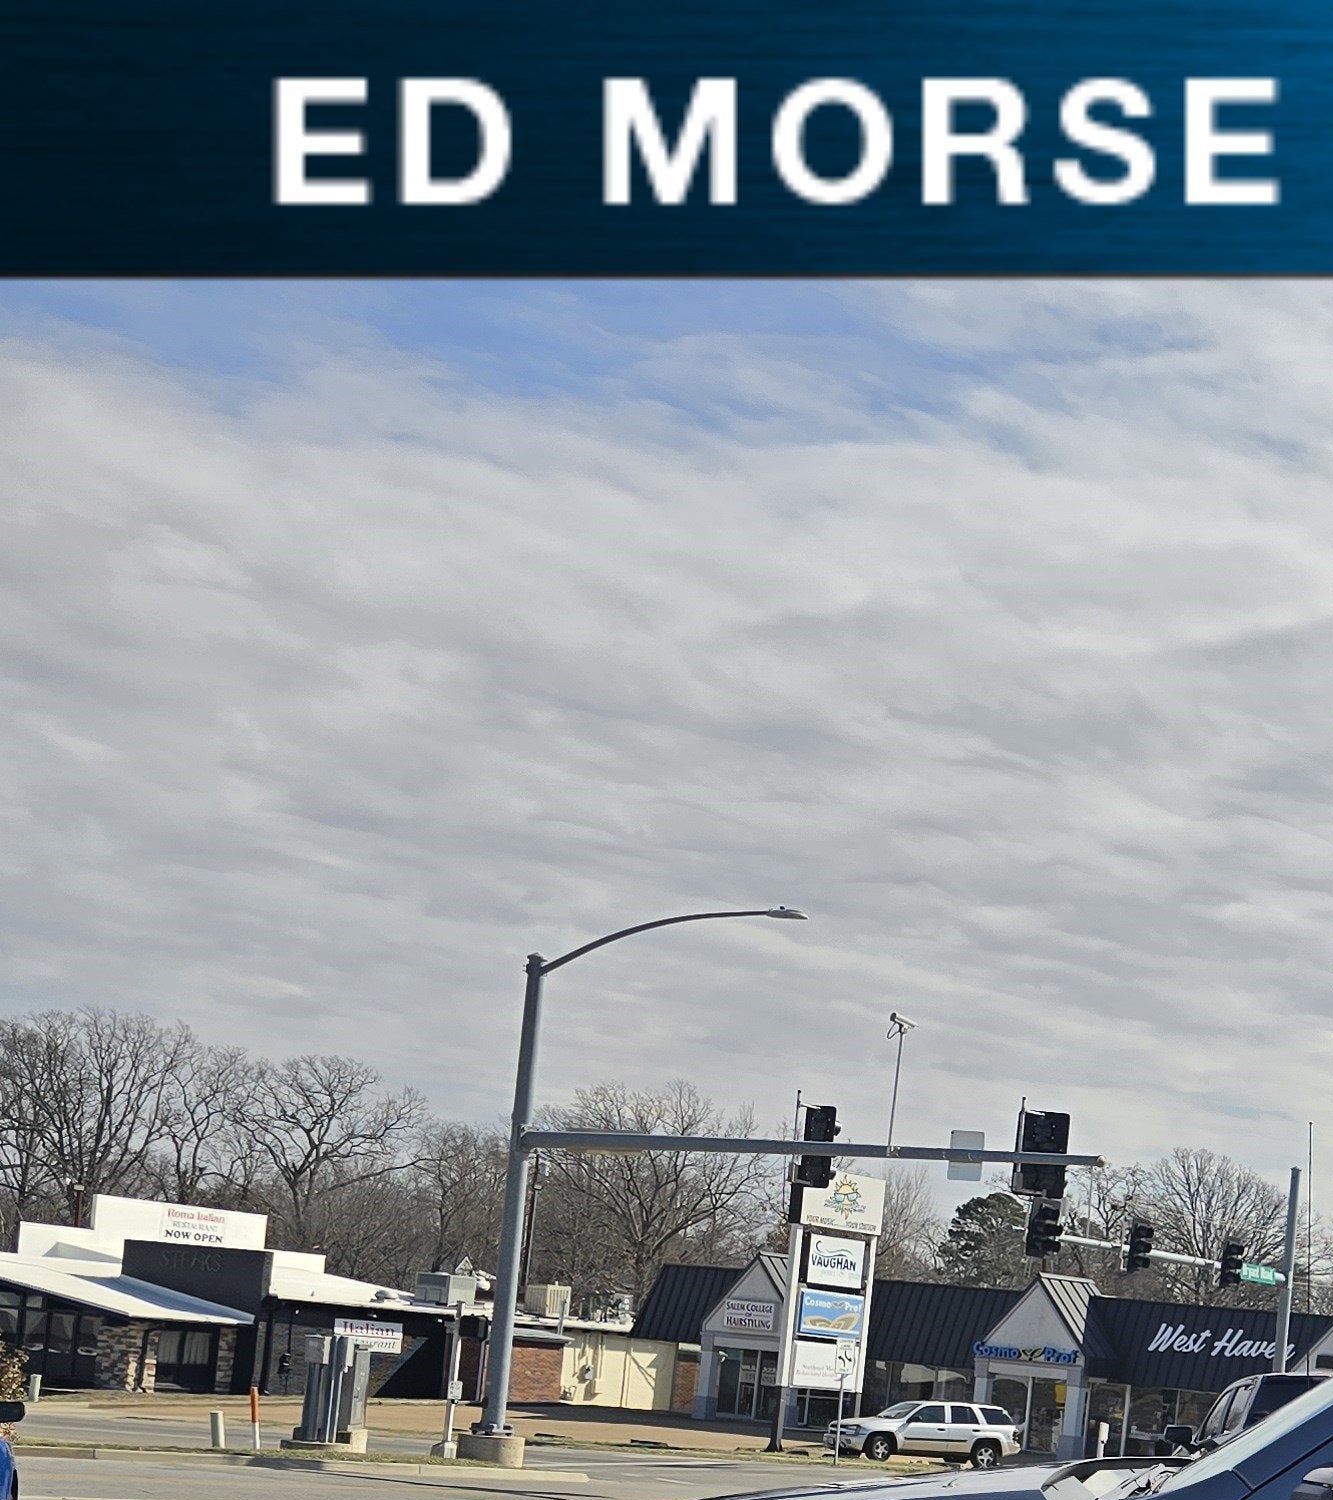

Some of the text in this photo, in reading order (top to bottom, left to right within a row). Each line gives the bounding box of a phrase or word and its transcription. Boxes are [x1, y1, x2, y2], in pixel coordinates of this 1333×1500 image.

[167, 1208, 225, 1224] Roma Italian
[165, 1229, 224, 1244] NOW OPEN
[811, 1253, 857, 1272] VAUGHAN
[726, 1301, 773, 1313] SALEM COLLEGE
[804, 1296, 832, 1309] Cosmo
[342, 1320, 395, 1337] Italian
[1147, 1322, 1212, 1354] West
[973, 1341, 1080, 1363] Cosmo Prof
